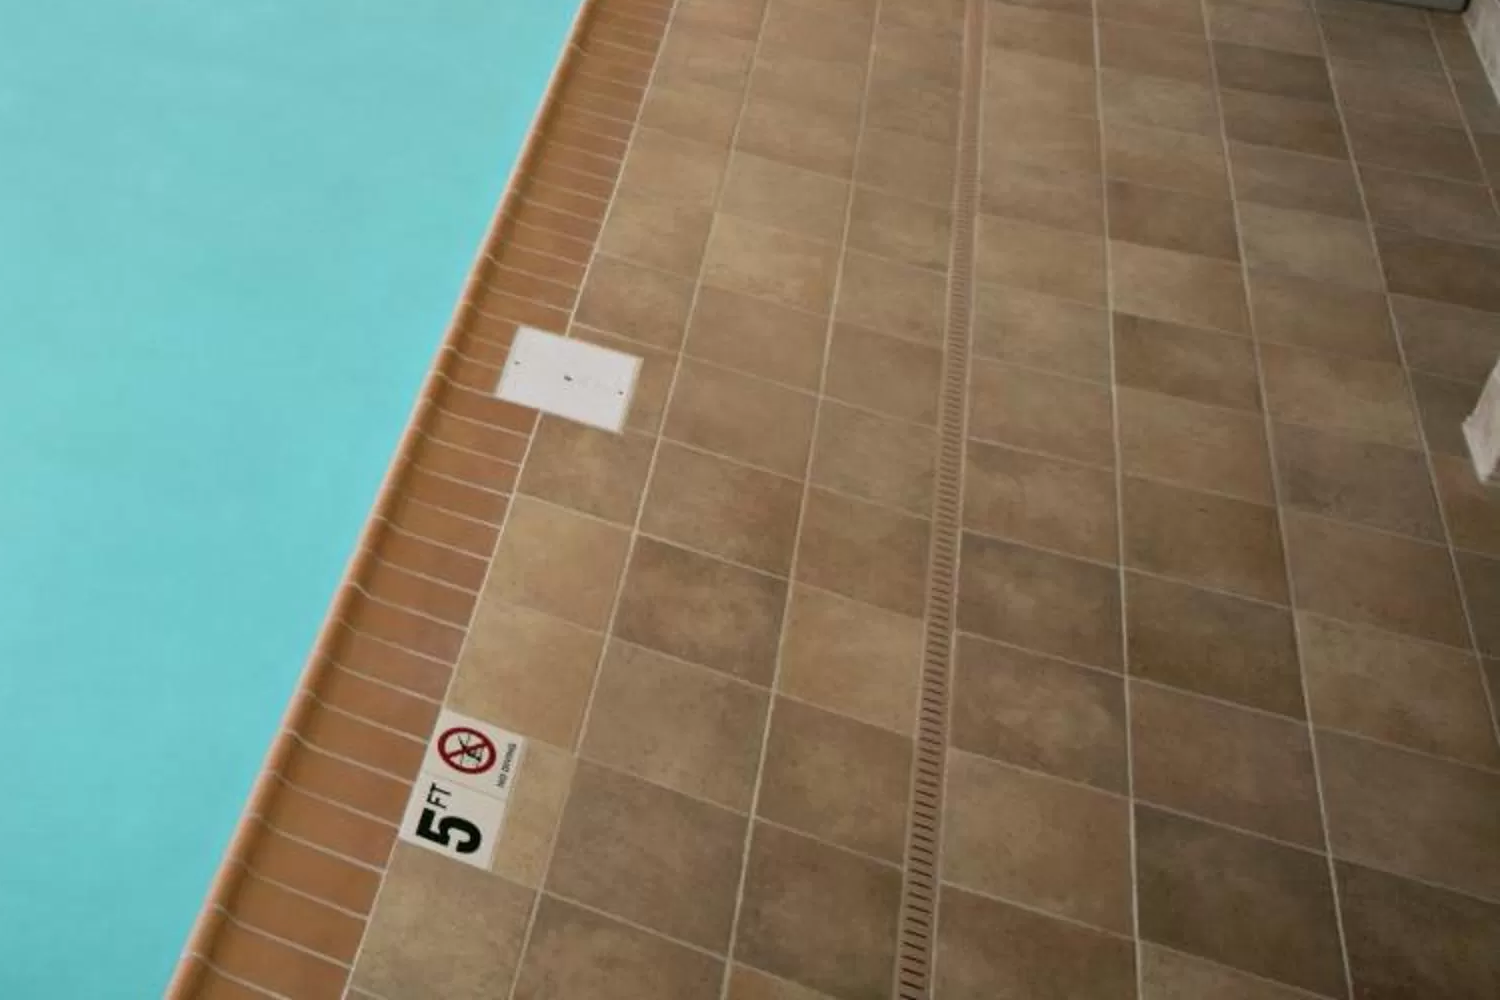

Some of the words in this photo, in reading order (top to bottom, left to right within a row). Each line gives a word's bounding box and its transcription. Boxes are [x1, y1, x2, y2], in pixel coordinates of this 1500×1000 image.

[494, 773, 508, 789] NO
[501, 743, 517, 773] DIVING
[426, 781, 453, 810] FT
[415, 807, 483, 855] 5
